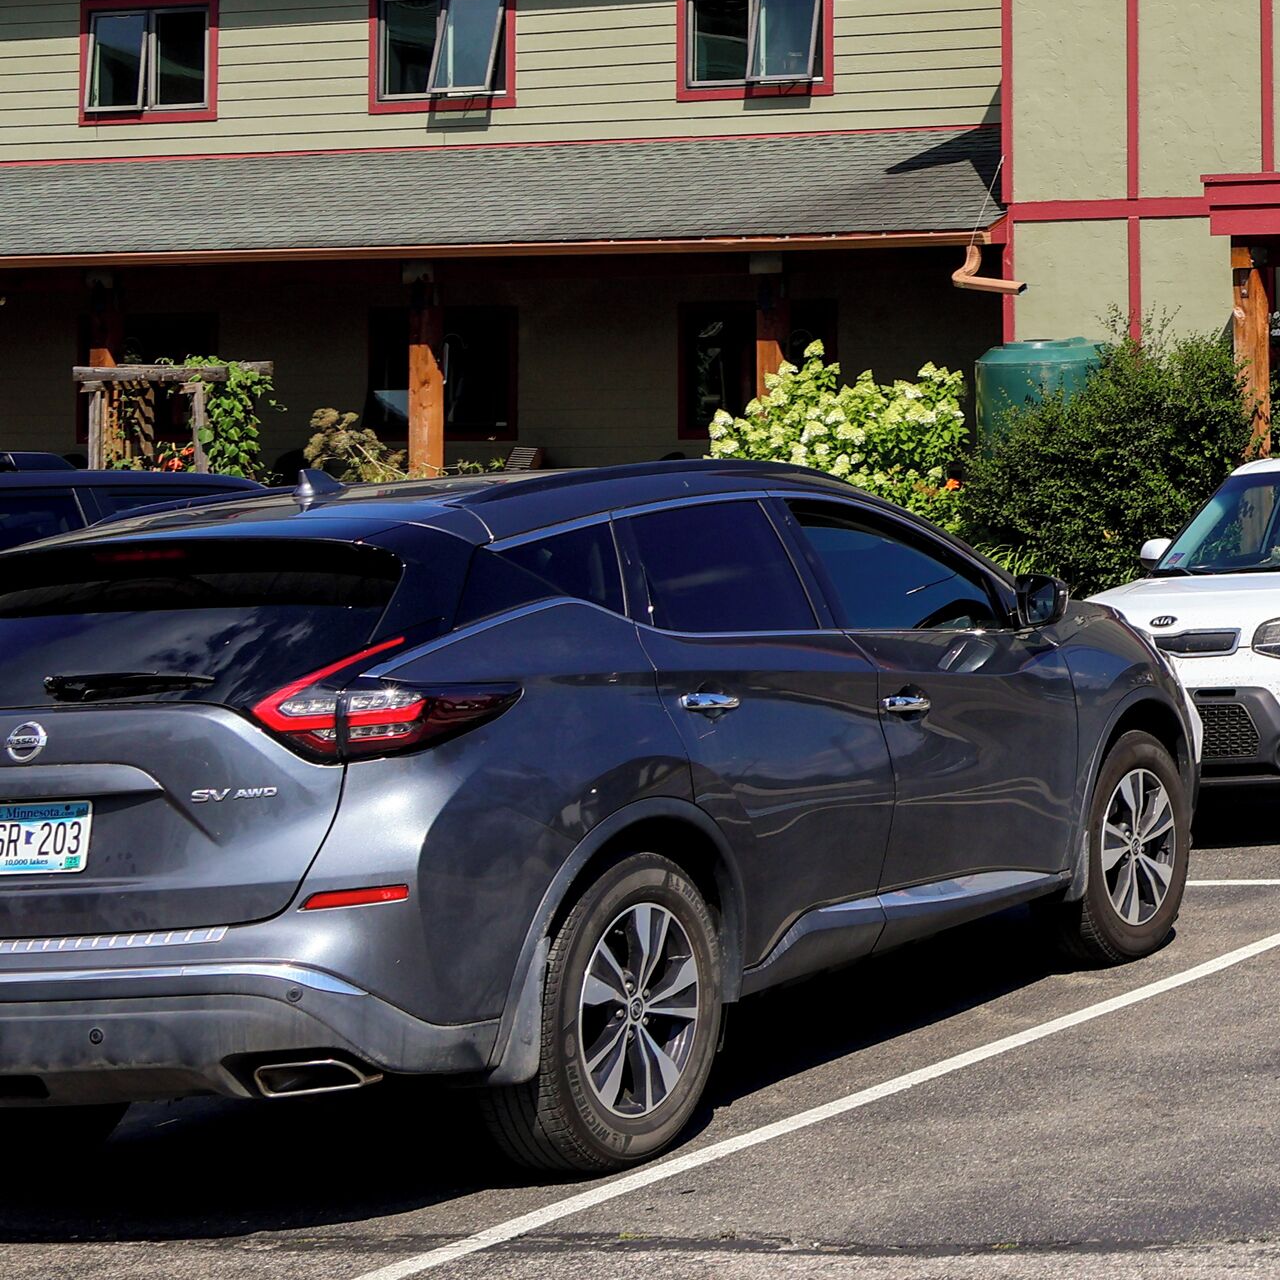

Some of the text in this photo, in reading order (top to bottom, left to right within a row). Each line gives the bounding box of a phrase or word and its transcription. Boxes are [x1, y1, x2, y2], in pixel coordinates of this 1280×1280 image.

[7, 737, 40, 746] NISSAN
[191, 786, 278, 804] SV AWD
[37, 821, 81, 856] 203
[565, 1065, 610, 1142] MICHELIN
